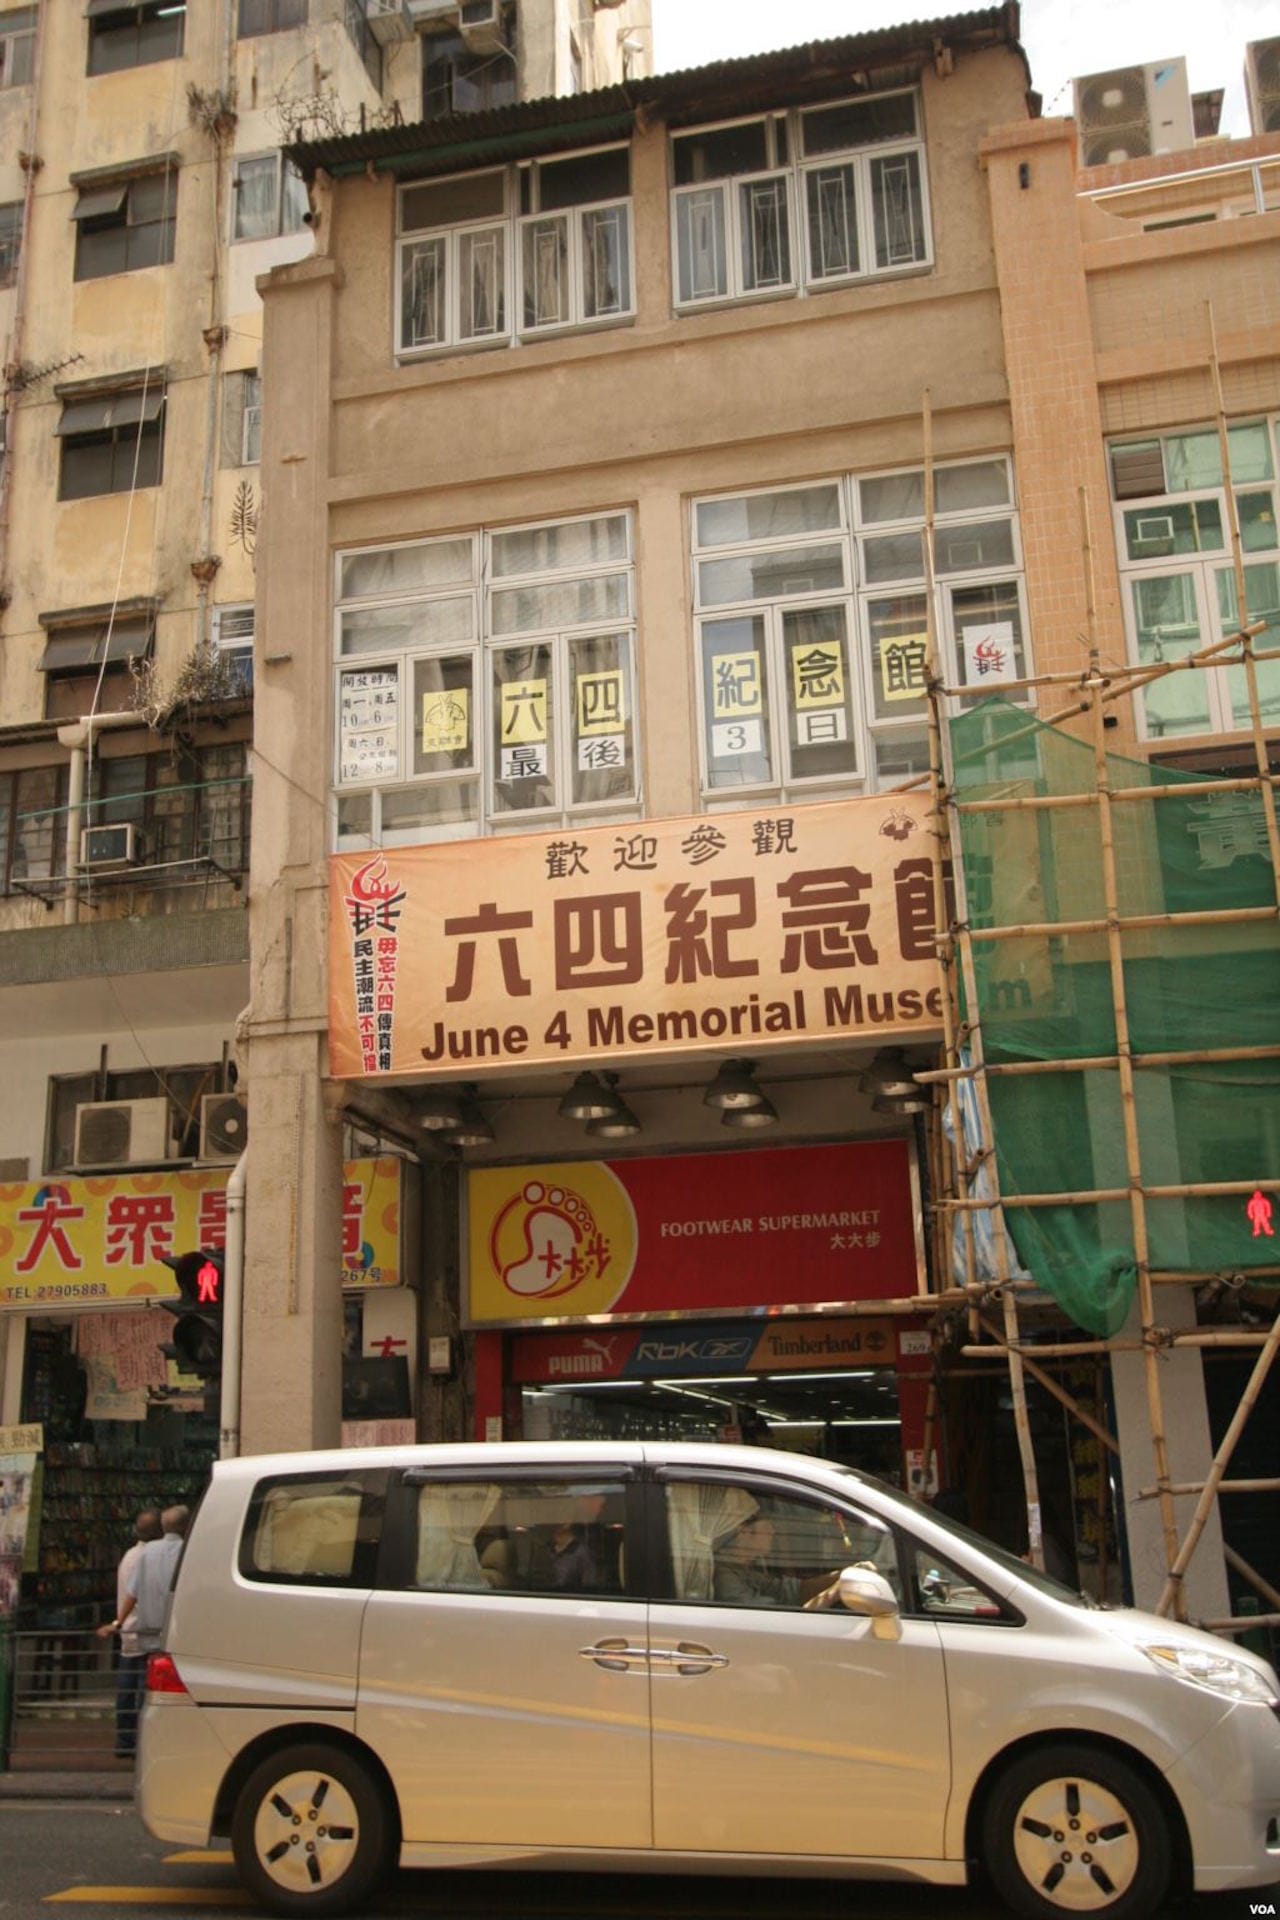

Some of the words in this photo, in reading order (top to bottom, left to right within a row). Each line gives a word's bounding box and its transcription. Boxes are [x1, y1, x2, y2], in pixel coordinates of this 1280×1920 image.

[546, 818, 798, 880] 歡迎參觀
[421, 1022, 528, 1061] June
[544, 1010, 571, 1049] 4
[587, 989, 807, 1048] Memorial
[661, 1217, 752, 1238] FOOTWEAR
[759, 1209, 881, 1232] SUPERMARKET
[830, 1231, 881, 1250] 大大步
[768, 1333, 861, 1356] Timberland
[549, 1356, 602, 1374] PUMA
